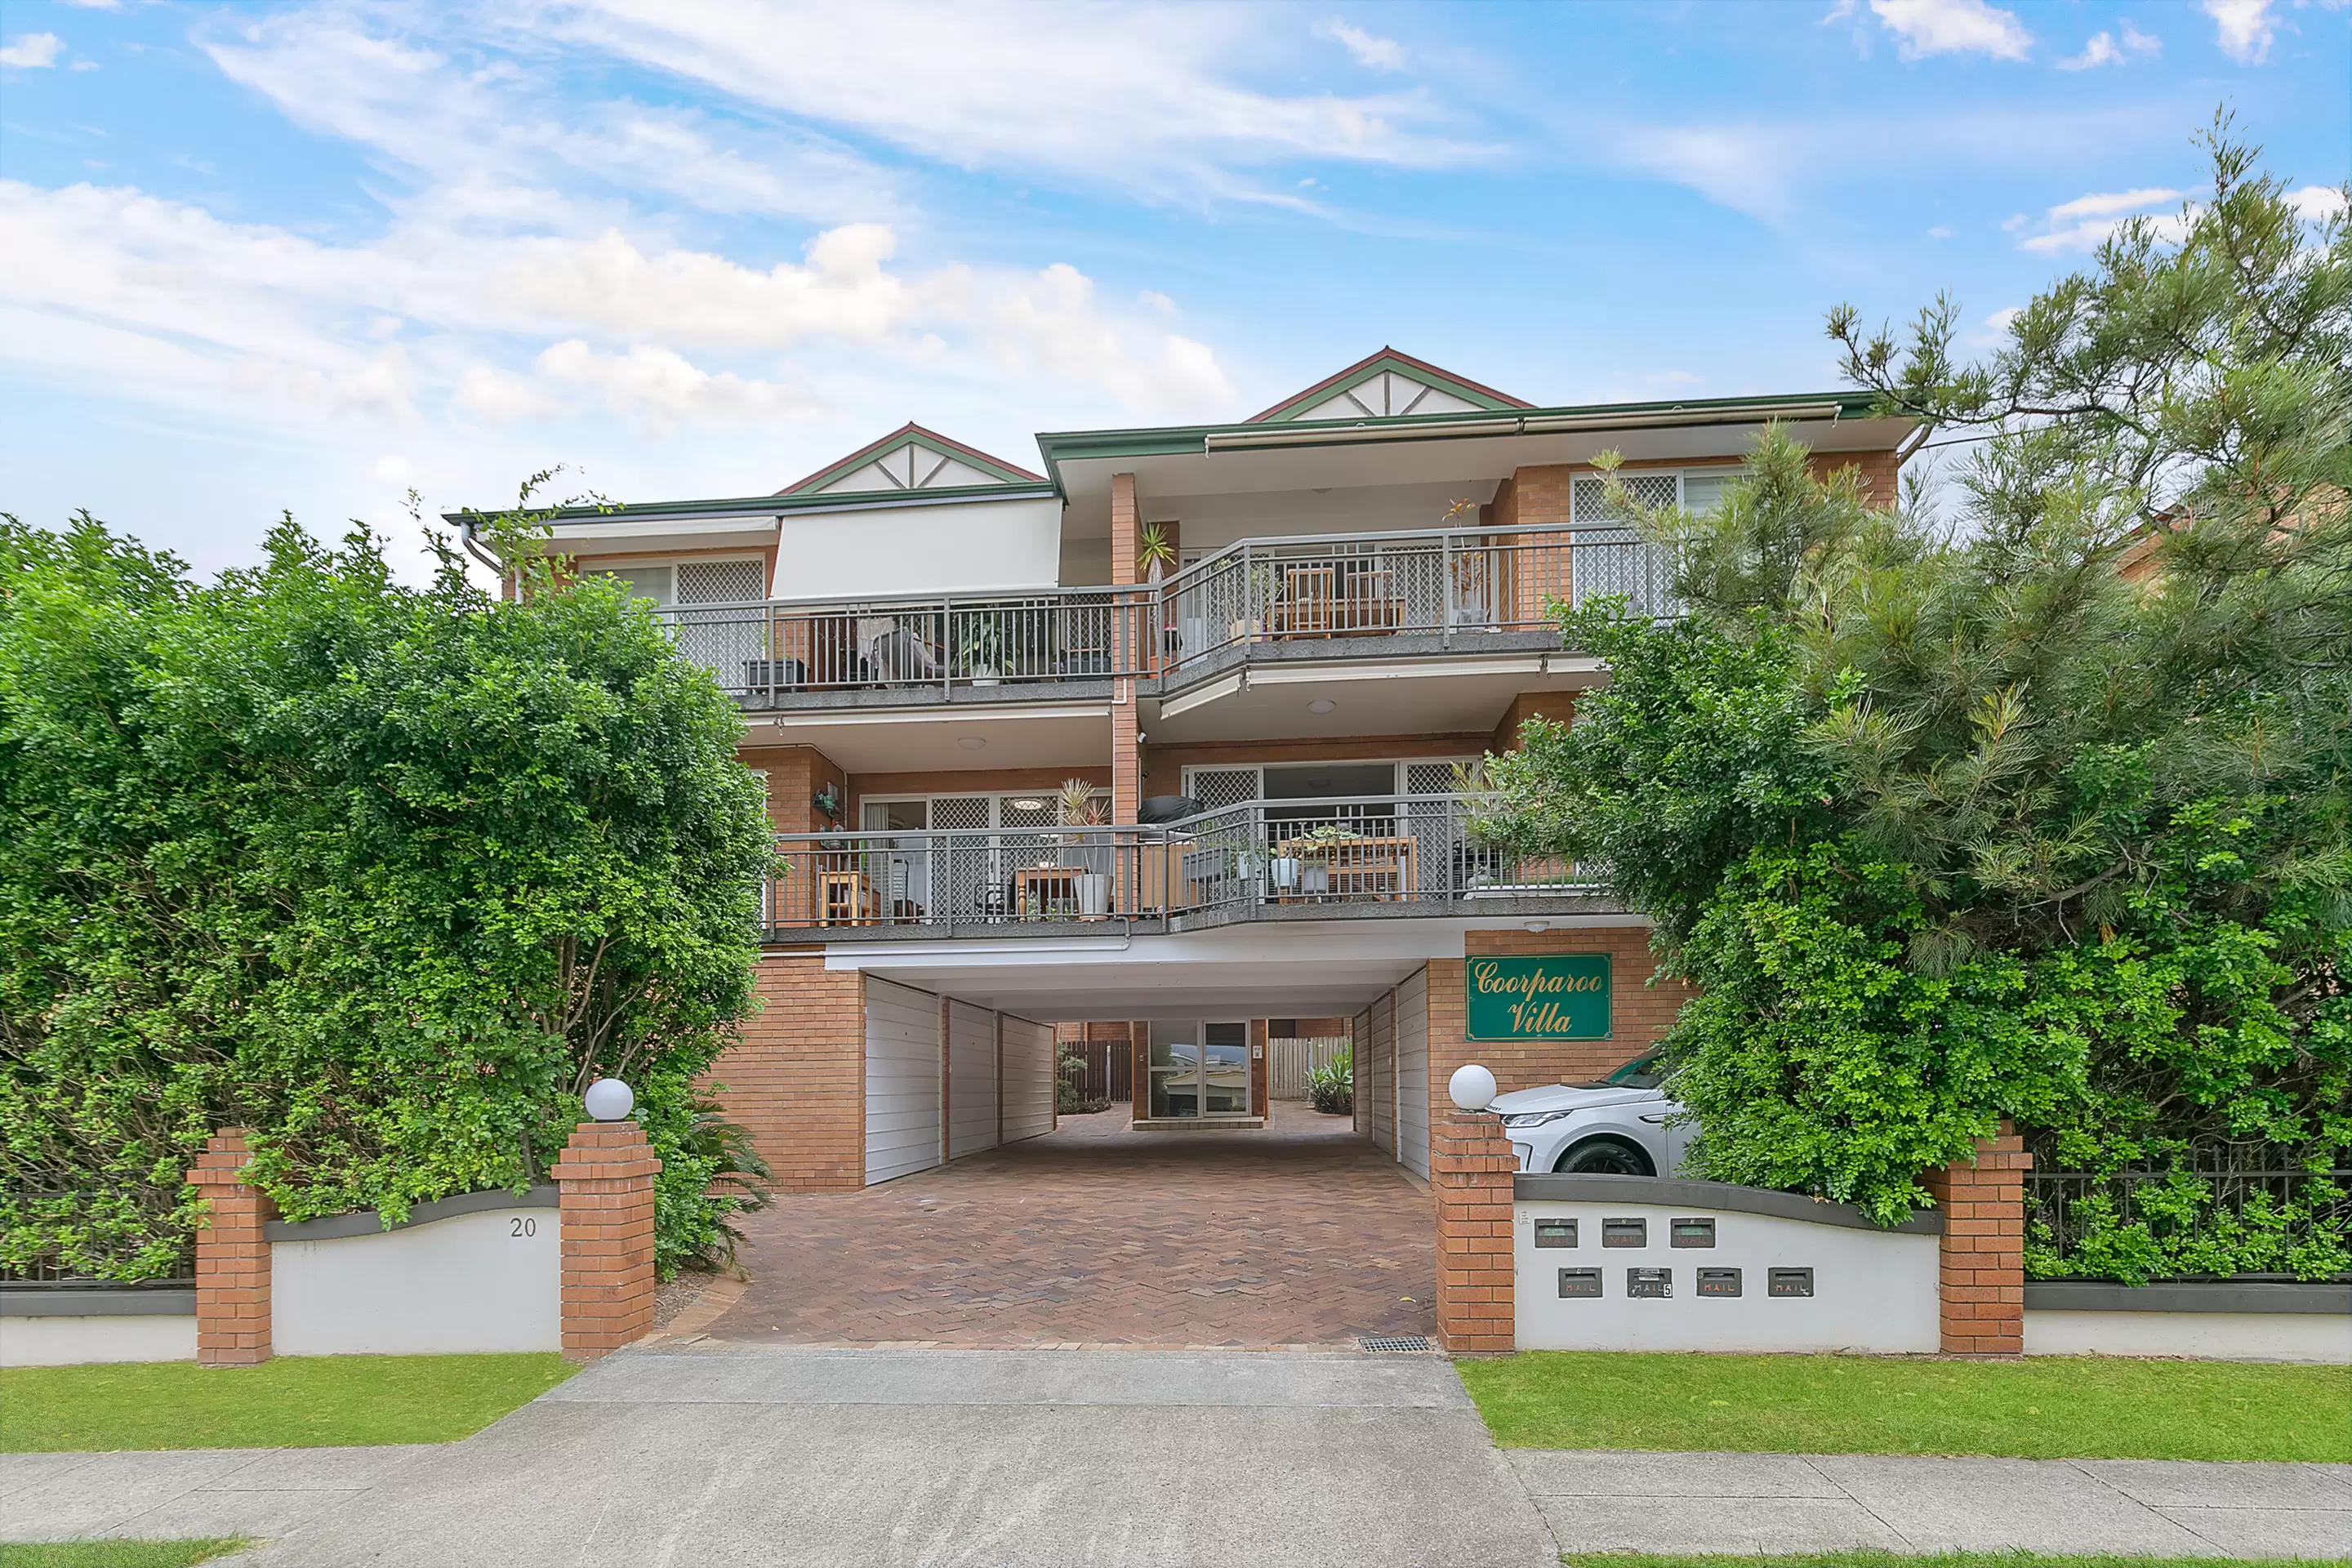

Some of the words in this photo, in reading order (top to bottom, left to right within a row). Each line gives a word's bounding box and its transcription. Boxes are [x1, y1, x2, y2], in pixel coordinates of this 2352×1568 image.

[1475, 962, 1602, 1001] Coorparoo
[1508, 1001, 1572, 1032] Villa
[510, 1218, 536, 1236] 20
[1542, 1236, 1571, 1245] MAIL
[1609, 1235, 1640, 1244] MAIL
[1678, 1236, 1708, 1245] MAIL
[1633, 1284, 1664, 1292] MAIL
[1665, 1285, 1671, 1295] 5
